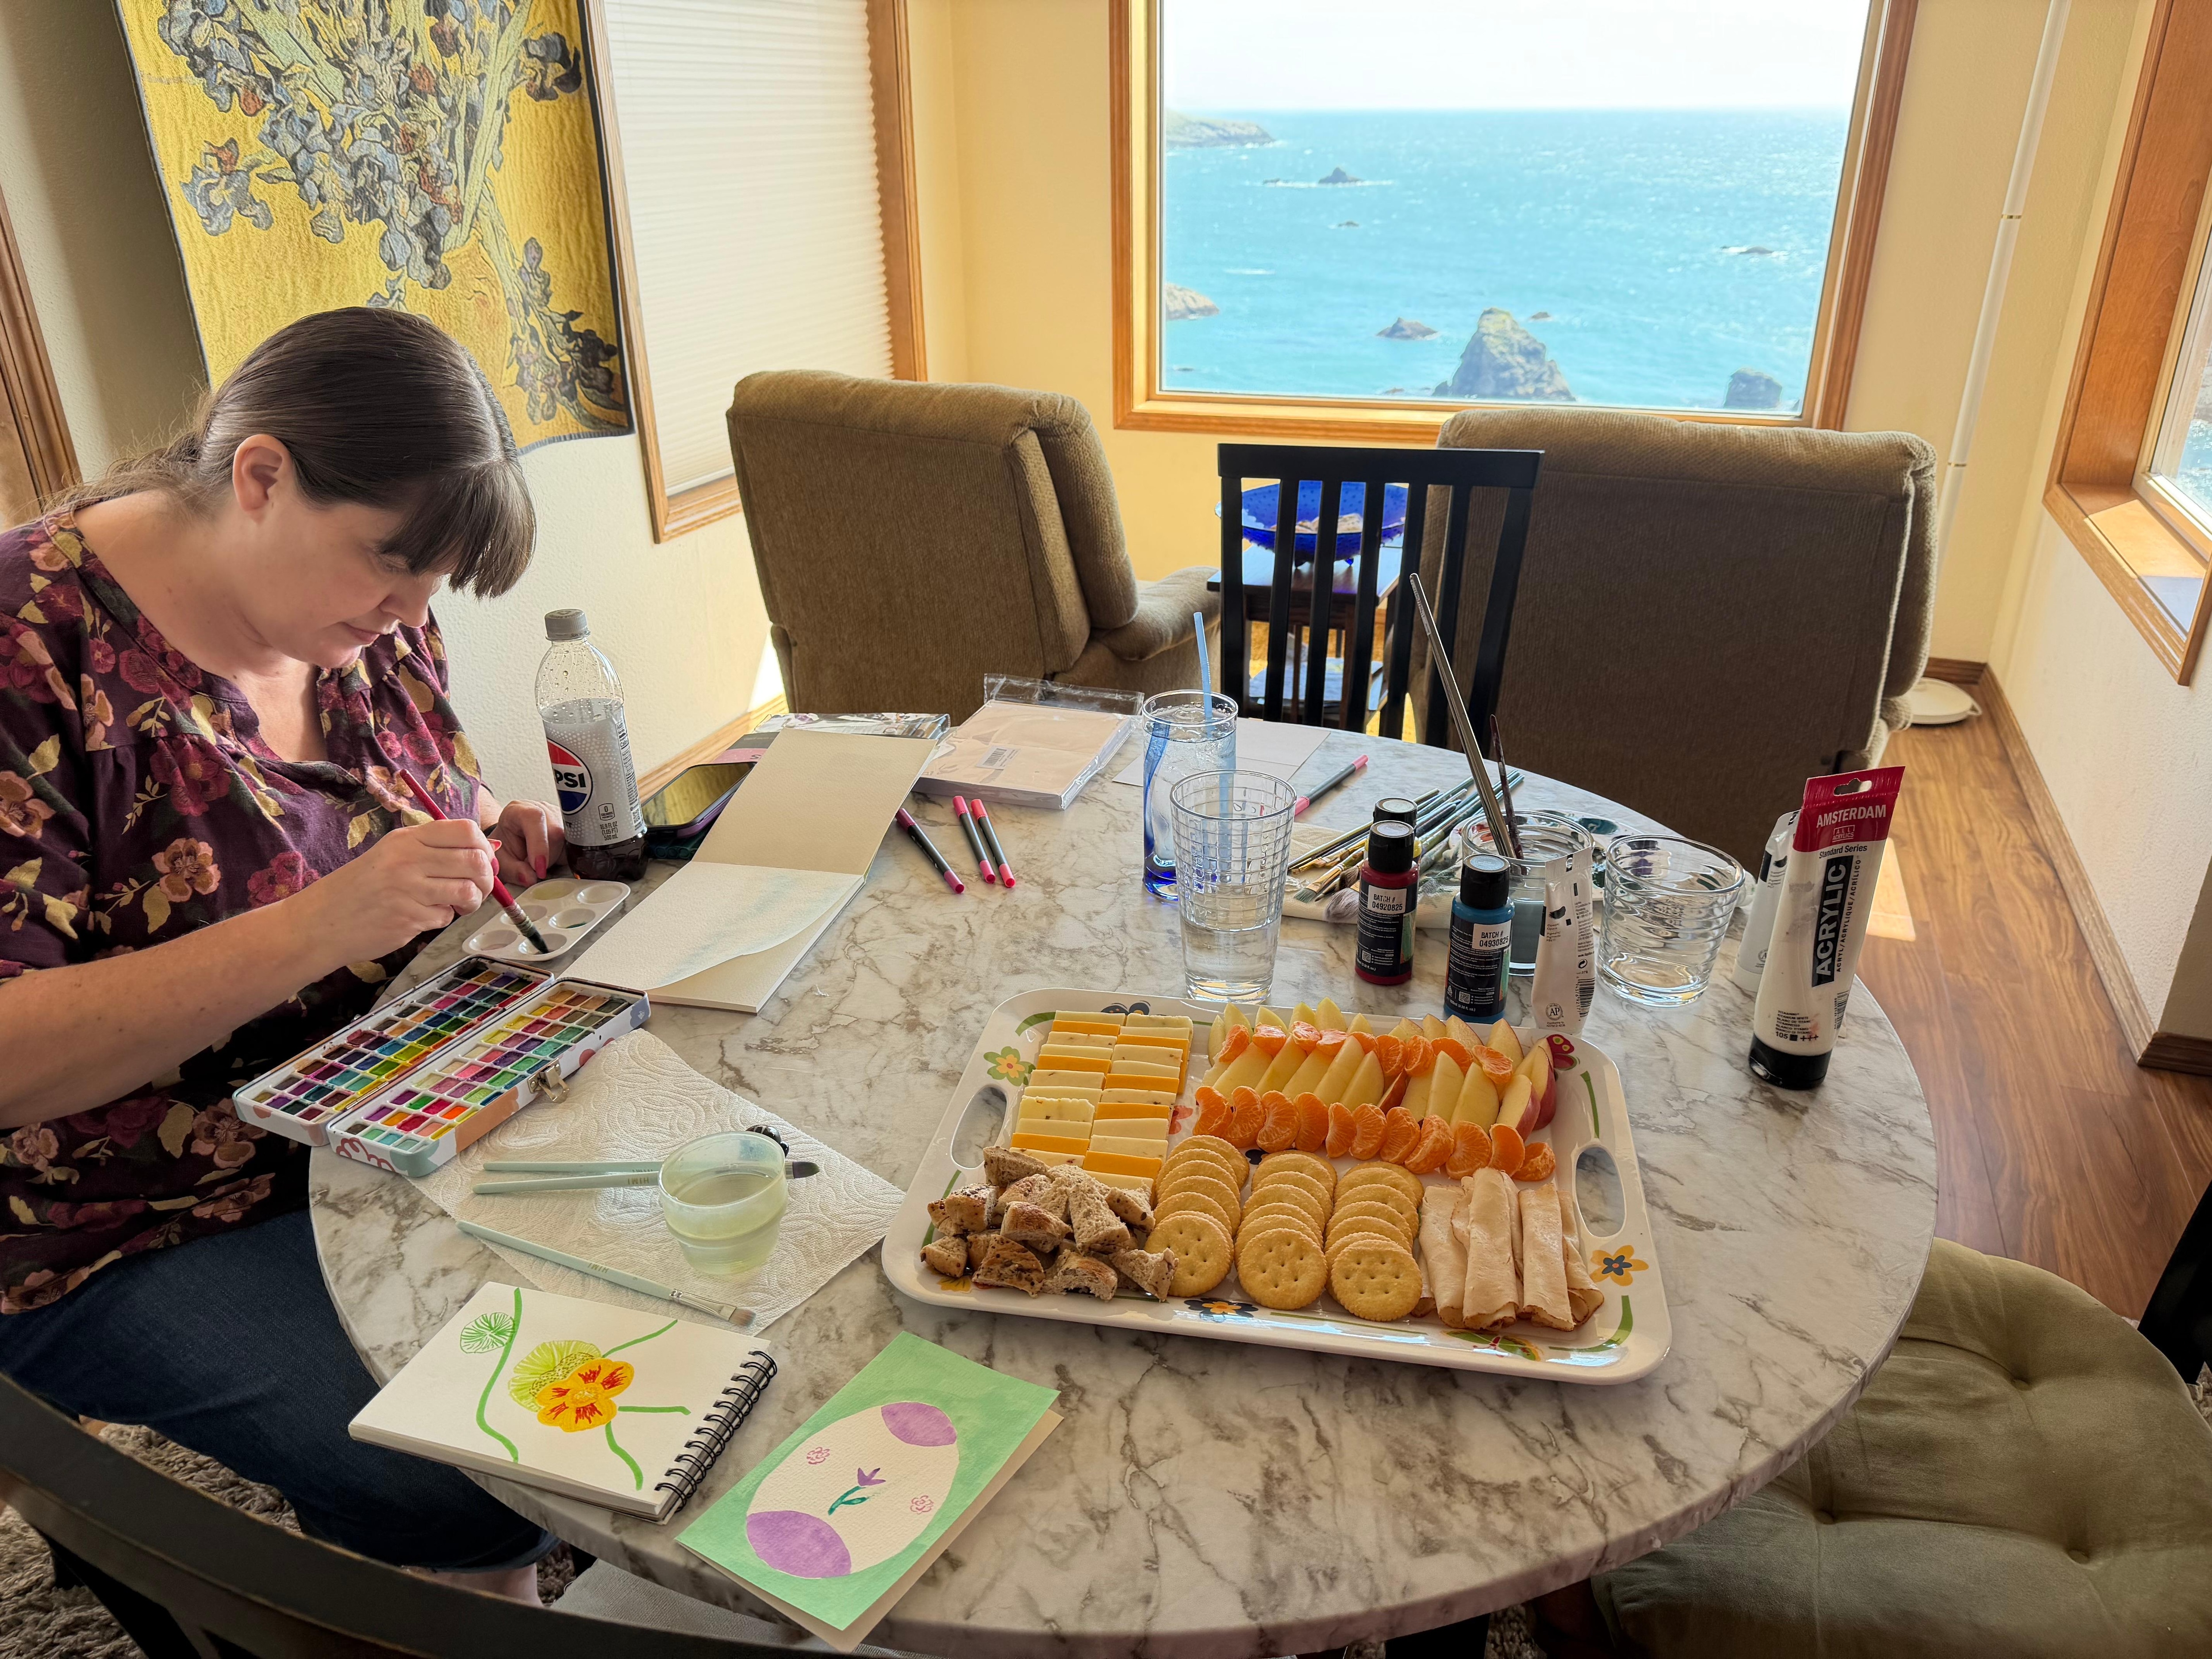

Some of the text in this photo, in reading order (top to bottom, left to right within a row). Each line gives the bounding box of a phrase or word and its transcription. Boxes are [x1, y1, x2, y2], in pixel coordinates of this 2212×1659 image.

[1816, 804, 1886, 828] AMSTERDAM
[1832, 832, 1855, 841] ACRYLICS
[1819, 844, 1868, 859] Standard Series
[1374, 894, 1390, 902] BATCH
[1372, 901, 1403, 911] 04920825
[1816, 864, 1847, 976] ACRYLIC
[1479, 936, 1509, 947] 04930825
[1549, 1007, 1560, 1016] AP
